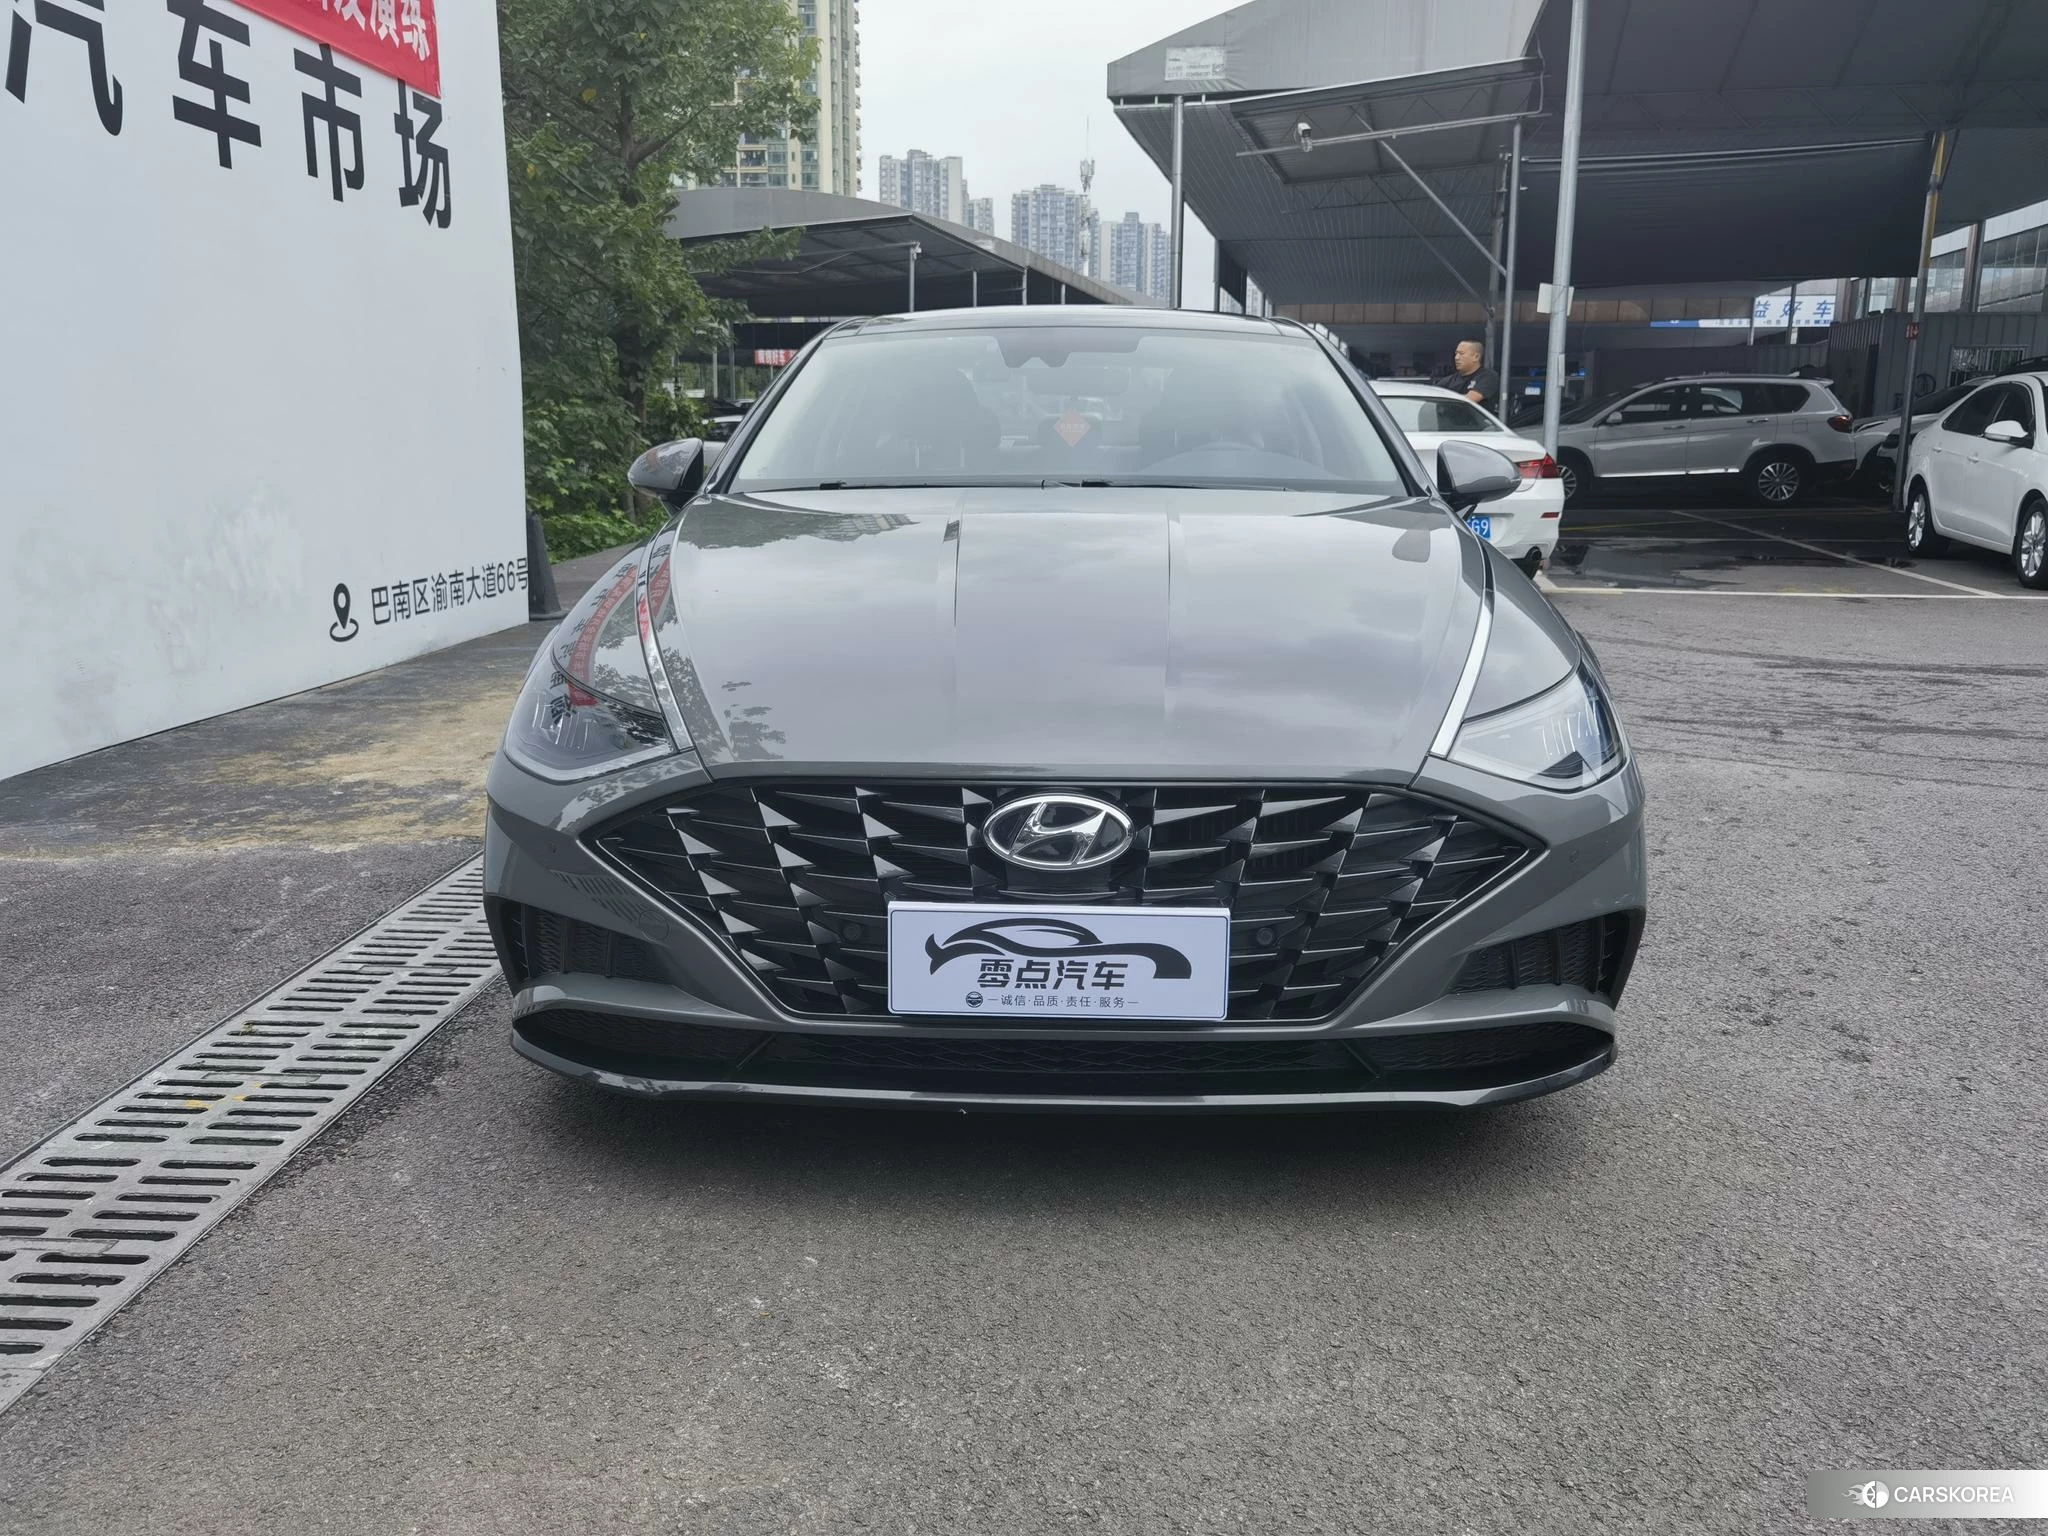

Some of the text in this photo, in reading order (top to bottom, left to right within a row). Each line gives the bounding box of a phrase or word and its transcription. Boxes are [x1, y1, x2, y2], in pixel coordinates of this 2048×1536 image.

[371, 557, 528, 625] 巴南区渝南大道66号
[977, 959, 1128, 990] 零点汽车
